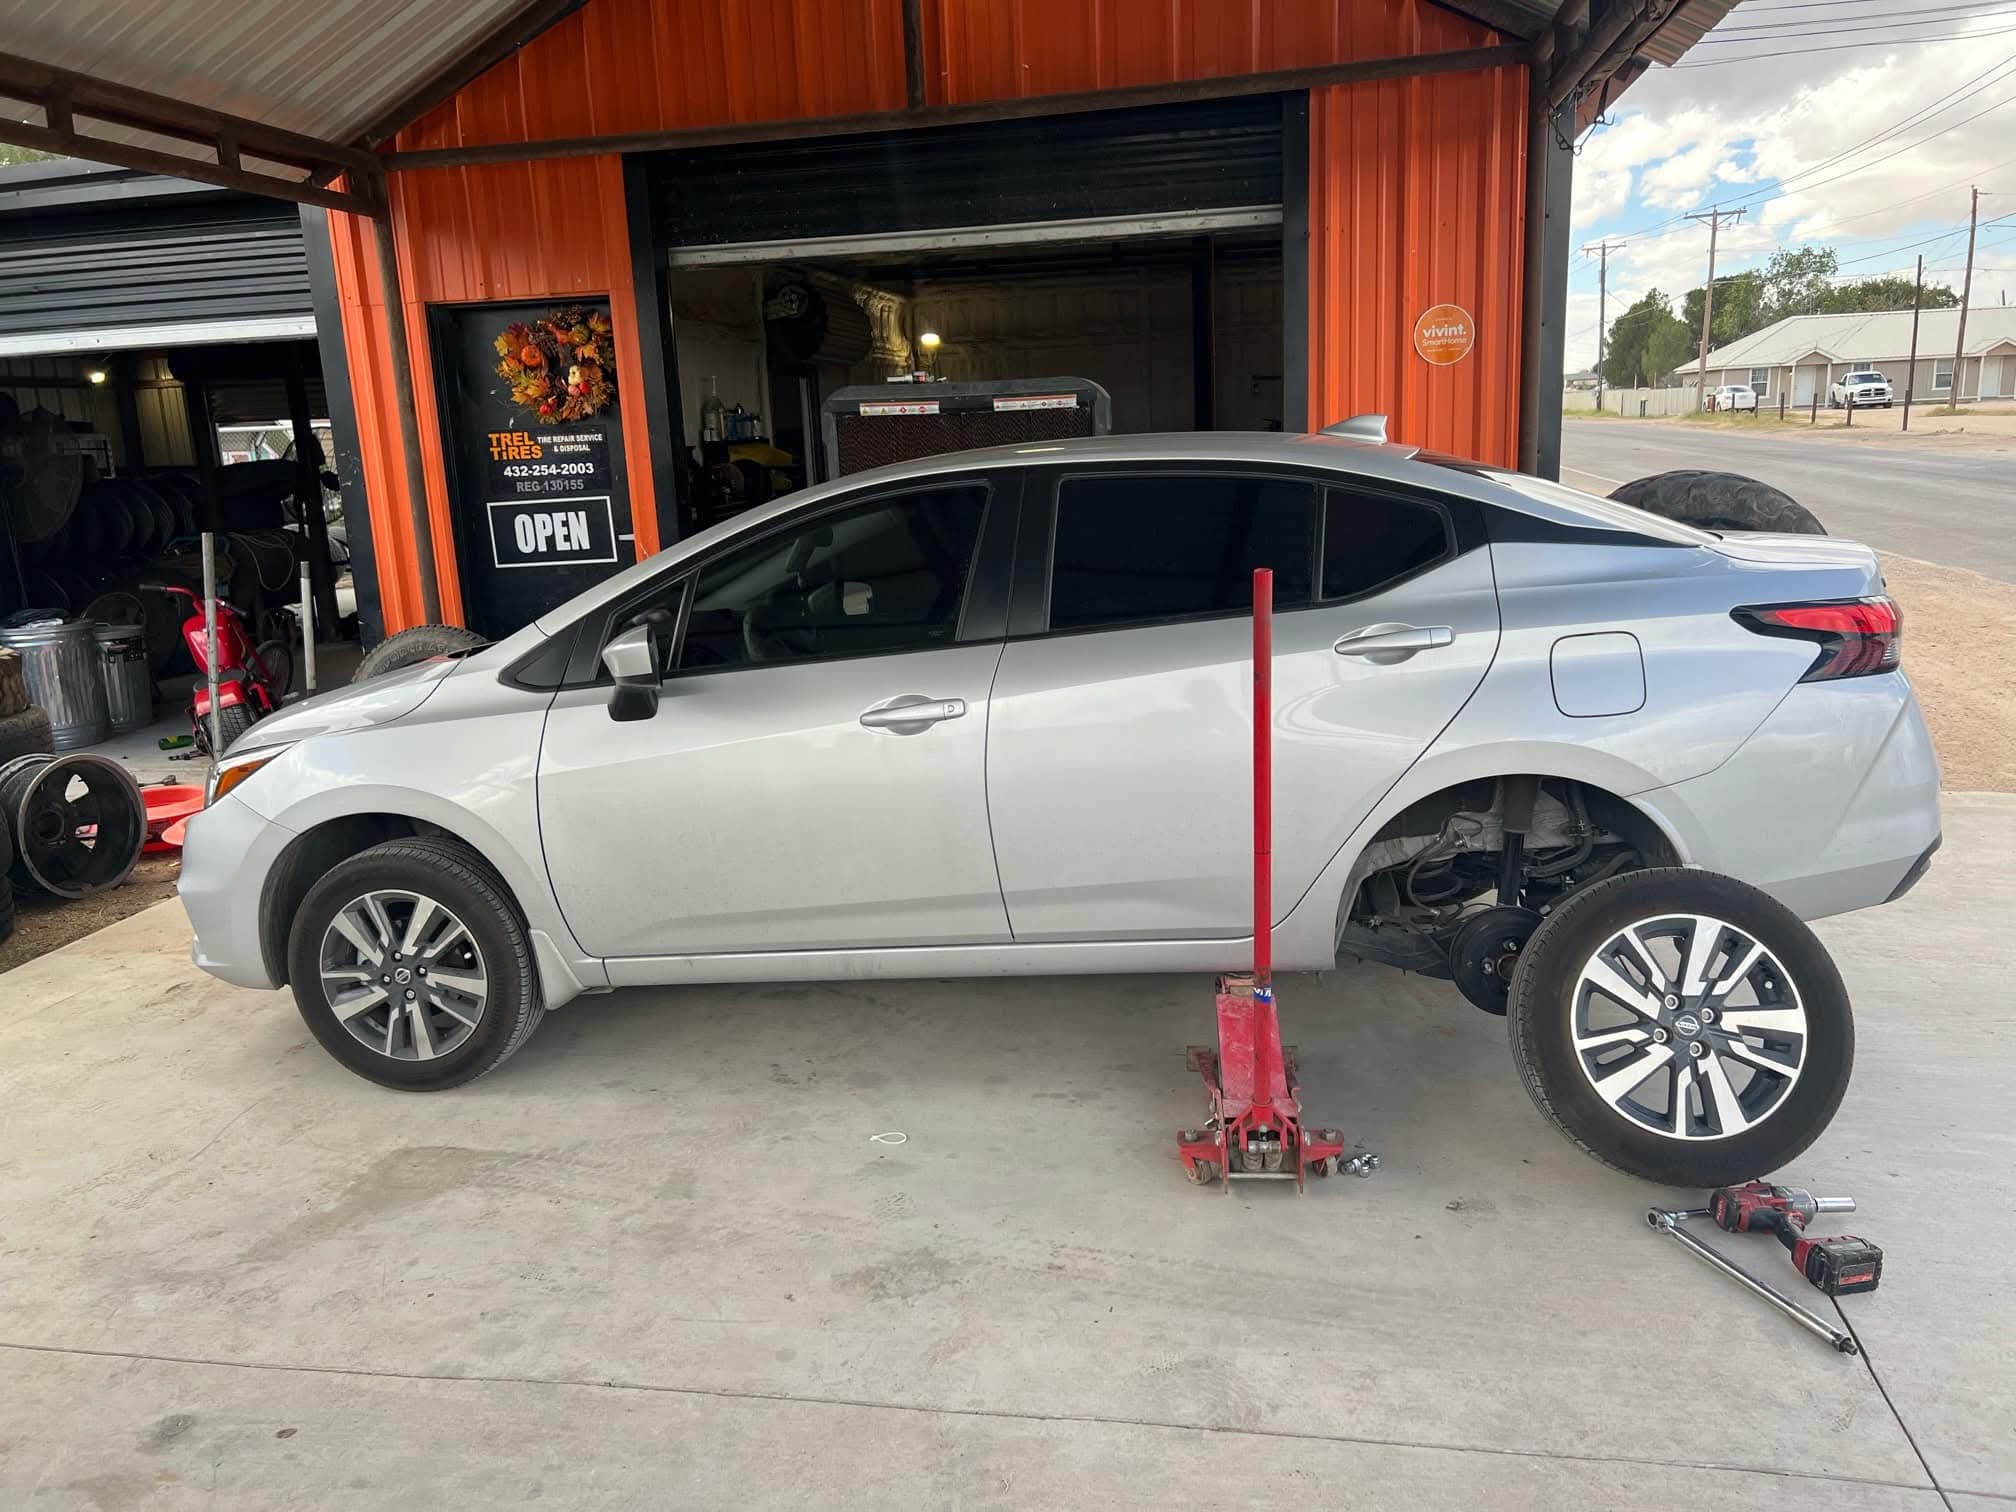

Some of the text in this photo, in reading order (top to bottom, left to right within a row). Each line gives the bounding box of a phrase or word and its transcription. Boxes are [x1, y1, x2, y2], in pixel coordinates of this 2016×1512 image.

[488, 431, 535, 447] TREL
[537, 433, 603, 444] TIRE REPAIR SERVICE
[560, 444, 591, 452] DISPOSAL
[503, 462, 595, 477] 432-254-2003
[543, 479, 584, 491] 130155
[514, 511, 591, 554] OPEN
